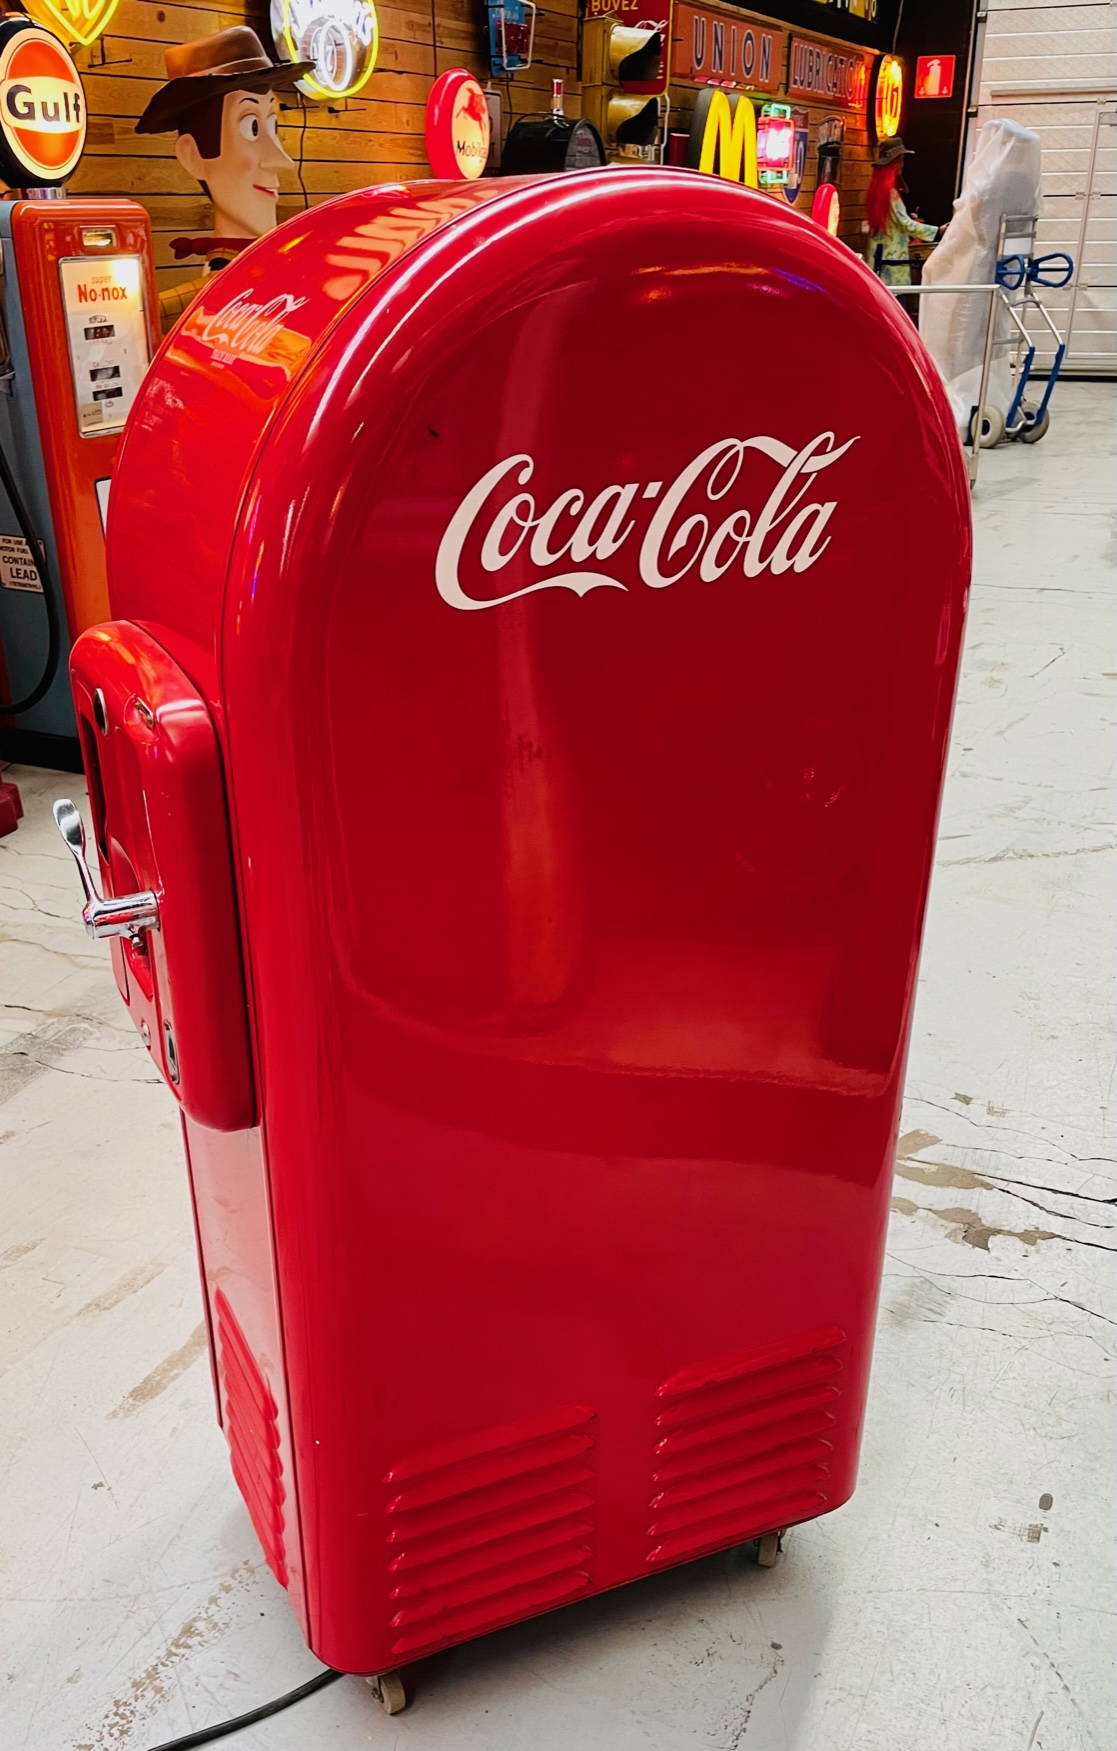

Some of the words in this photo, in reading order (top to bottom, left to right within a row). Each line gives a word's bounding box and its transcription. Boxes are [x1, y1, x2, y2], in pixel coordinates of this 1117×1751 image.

[693, 15, 772, 83] UNION
[6, 84, 82, 123] Gulf
[91, 275, 112, 285] super
[77, 284, 128, 303] No-nox
[435, 431, 861, 610] Coca-Cola
[2, 556, 35, 567] CONTAIN
[10, 567, 38, 581] LEAD
